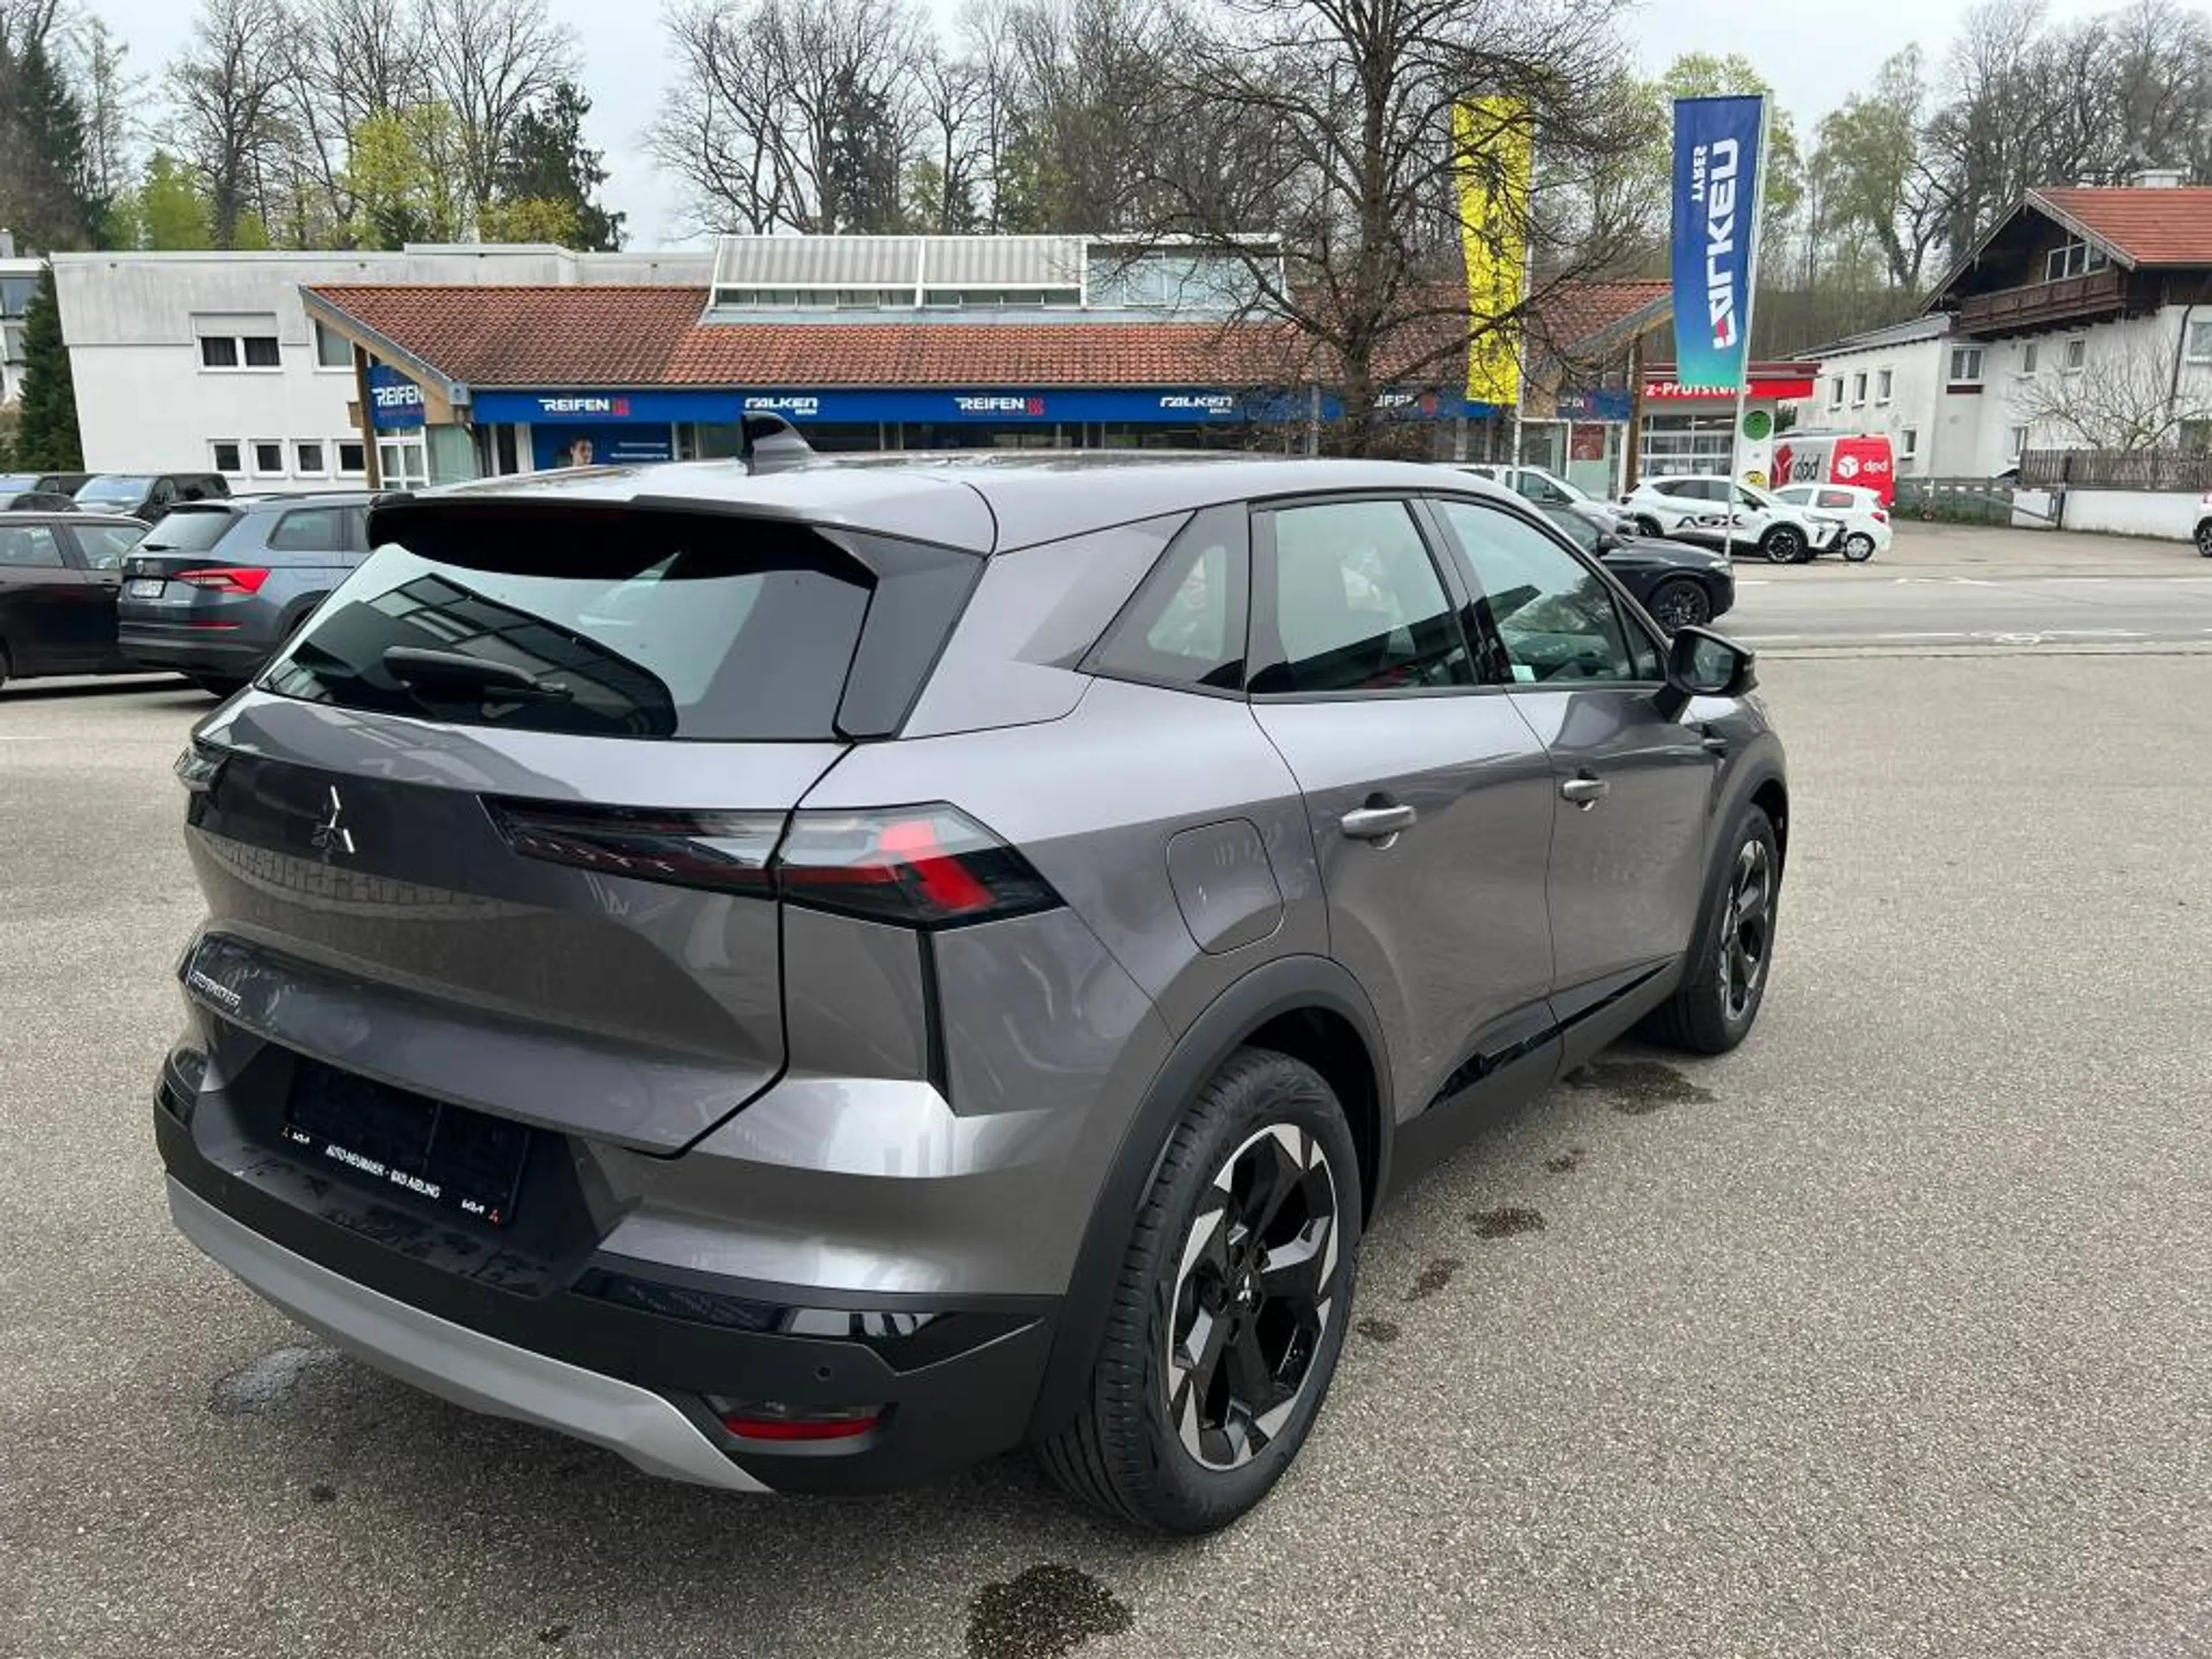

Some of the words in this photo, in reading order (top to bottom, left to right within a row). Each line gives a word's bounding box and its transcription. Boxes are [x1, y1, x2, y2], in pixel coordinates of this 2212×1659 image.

[538, 399, 610, 411] REIFEN
[745, 397, 818, 408] FALKEN
[953, 397, 1025, 410] REIFEN
[1160, 397, 1232, 407] FALKEN
[1793, 452, 1822, 482] dpd
[1863, 461, 1888, 474] dpd
